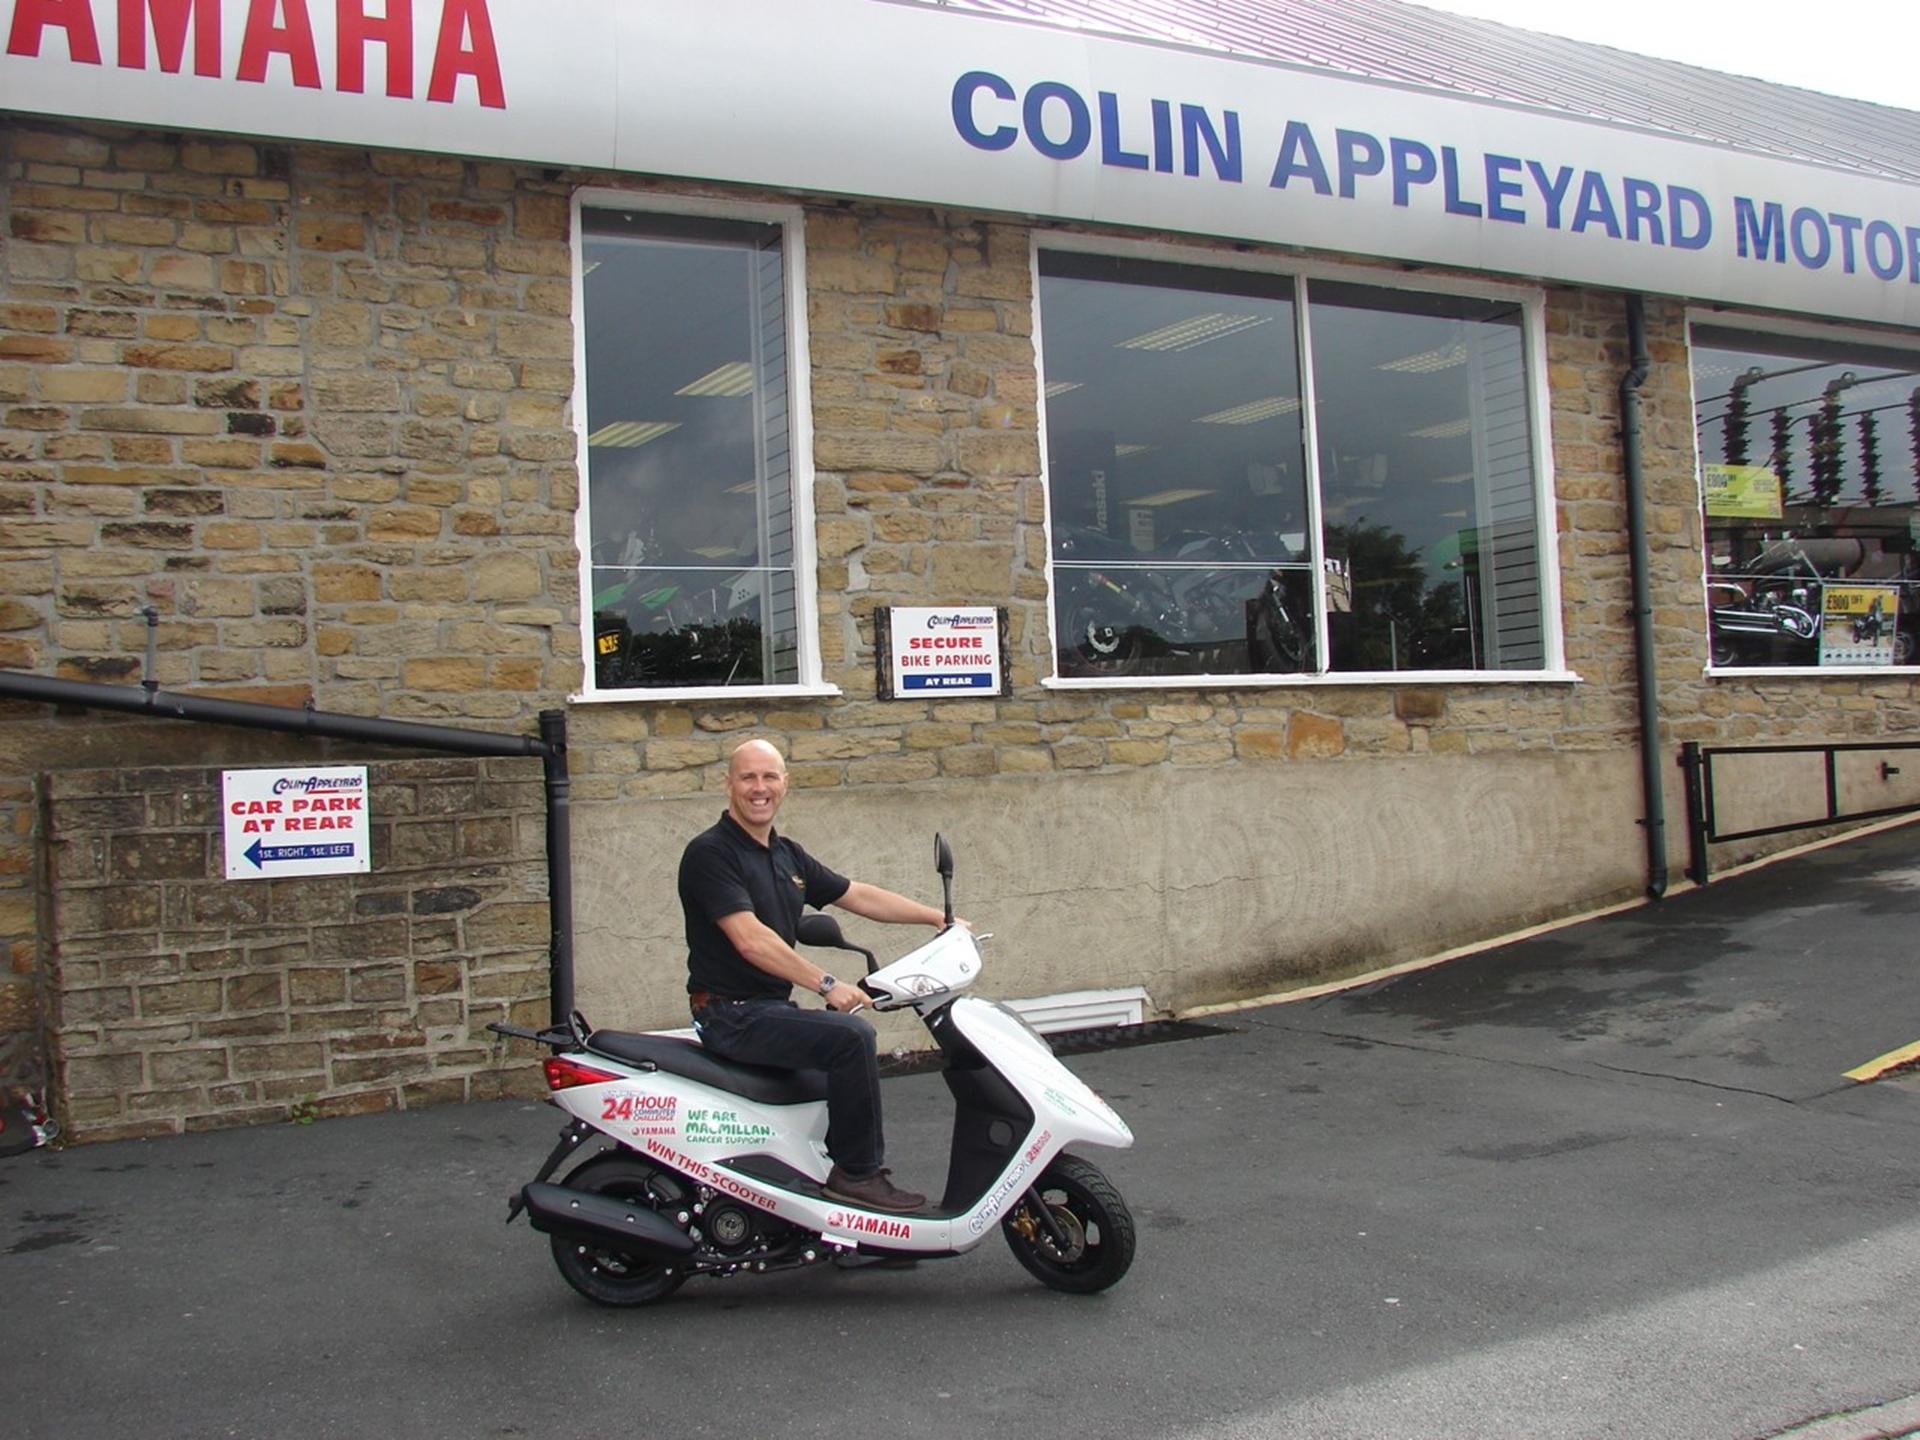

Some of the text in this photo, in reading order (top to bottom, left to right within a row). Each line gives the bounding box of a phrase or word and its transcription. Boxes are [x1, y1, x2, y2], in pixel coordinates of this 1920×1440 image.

[951, 70, 1243, 183] COLIN
[1269, 120, 1713, 250] APPLEYARD
[910, 637, 983, 649] SECURE
[901, 654, 992, 667] BIKE PARKING
[925, 677, 972, 686] AT REAR
[231, 797, 362, 815] CAR PARK
[242, 816, 353, 833] AT REAR
[330, 845, 350, 855] LEFT
[601, 1096, 677, 1120] 24 HOUR
[688, 1110, 737, 1122] WE ARE
[640, 1127, 676, 1135] YAMAHA
[686, 1135, 766, 1144] CANCER SUPPORT
[647, 1138, 777, 1210] WIN THIS SCOOTER
[846, 1213, 910, 1239] YAMAHA
